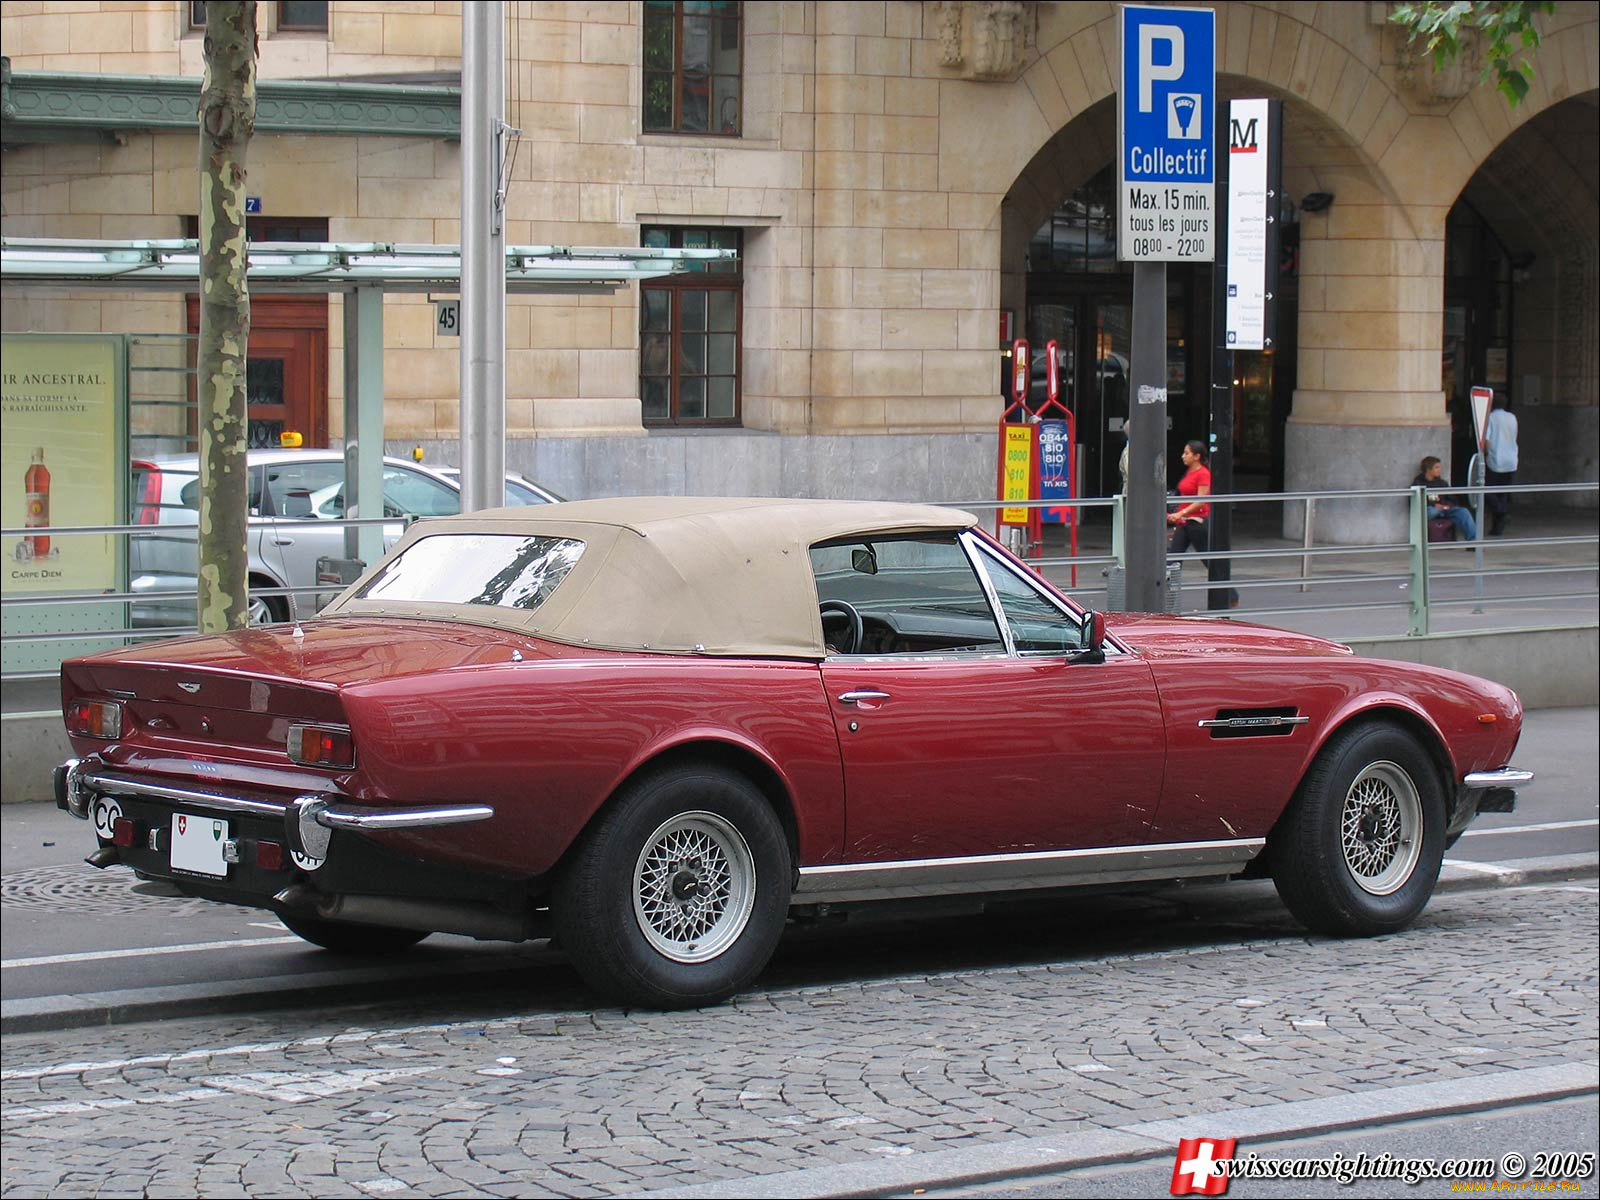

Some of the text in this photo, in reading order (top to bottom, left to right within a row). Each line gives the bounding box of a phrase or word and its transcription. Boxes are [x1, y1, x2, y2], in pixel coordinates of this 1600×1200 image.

[1139, 24, 1184, 113] P
[1231, 118, 1258, 147] M
[1131, 146, 1207, 175] Collectif
[1130, 188, 1210, 211] Max. 15 min.
[1130, 214, 1208, 236] tous les jours
[439, 307, 455, 329] 45
[22, 374, 106, 385] ANCESTRAL.
